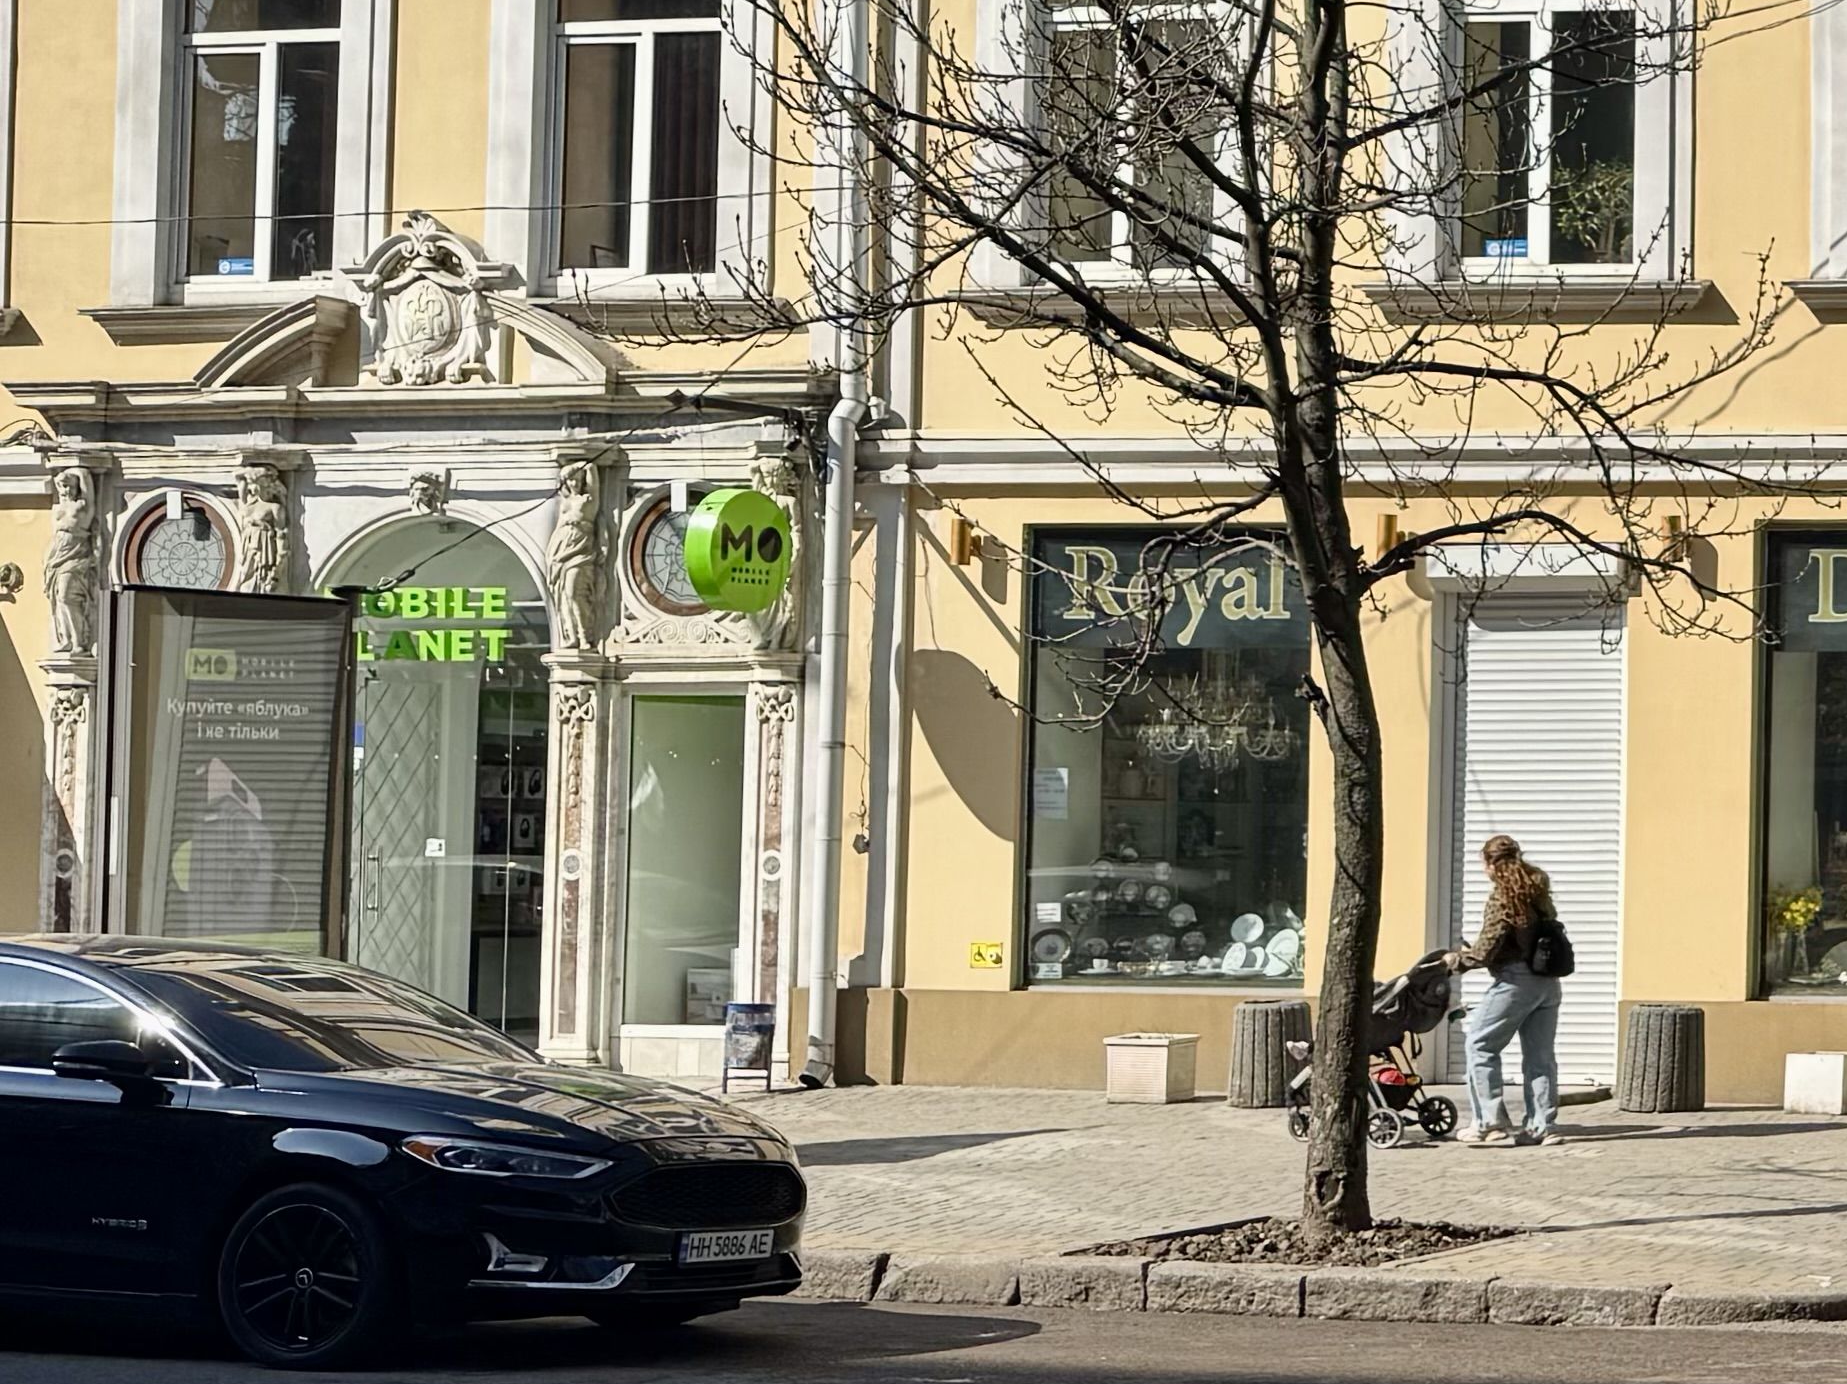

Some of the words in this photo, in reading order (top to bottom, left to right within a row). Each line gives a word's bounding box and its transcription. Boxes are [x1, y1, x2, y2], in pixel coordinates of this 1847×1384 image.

[324, 587, 507, 619] OBILE
[1063, 541, 1291, 646] Royal
[357, 629, 512, 662] LANET
[167, 698, 233, 717] Купуйте
[228, 722, 280, 740] тільки
[749, 1233, 769, 1255] AE
